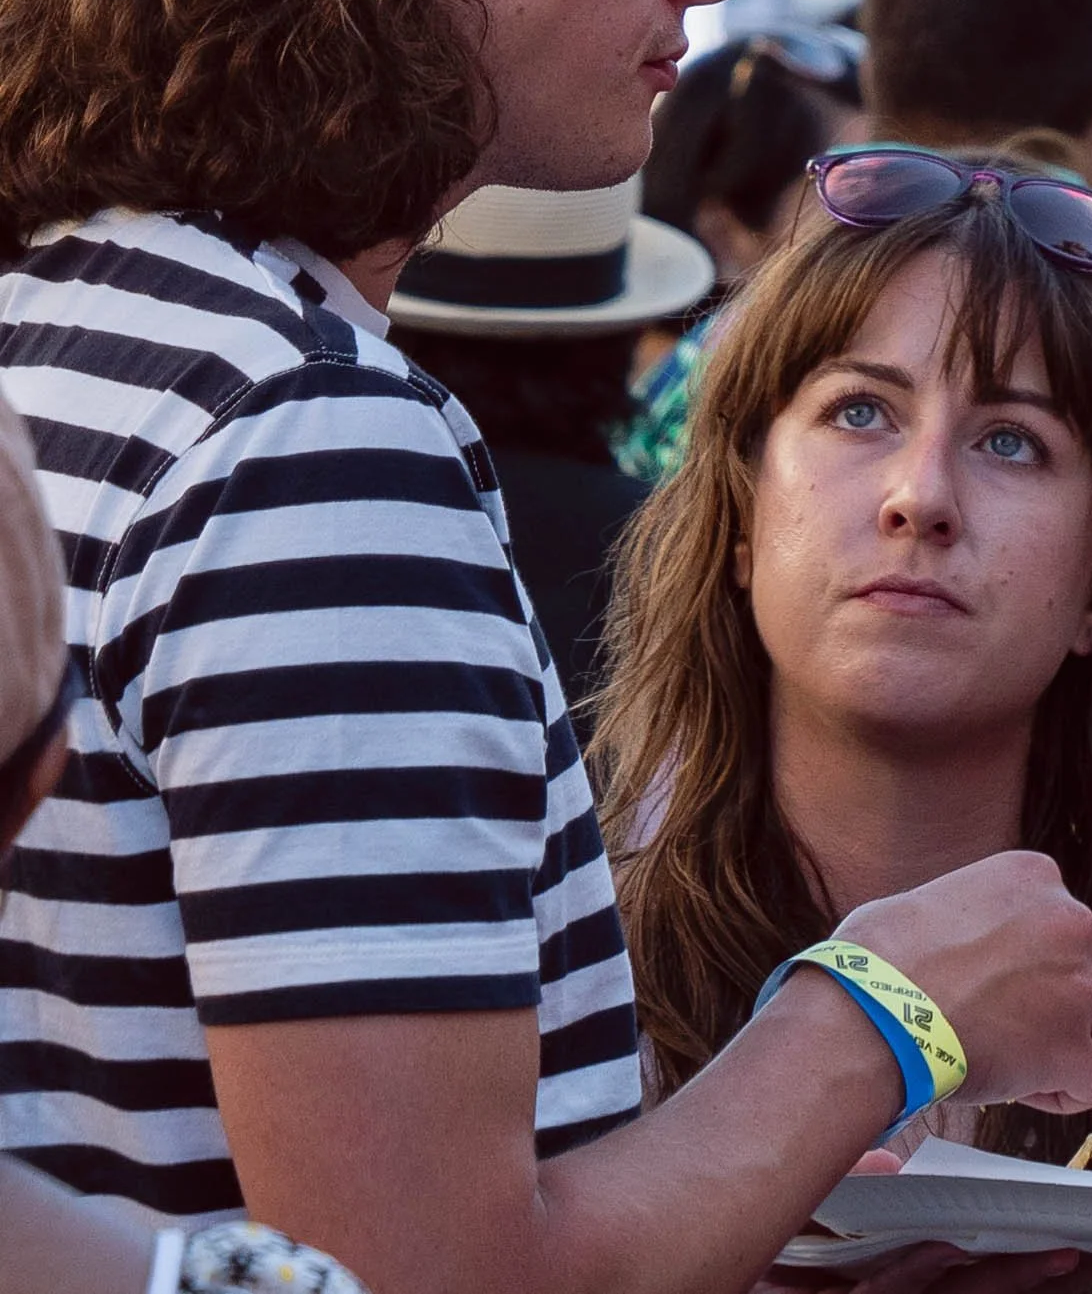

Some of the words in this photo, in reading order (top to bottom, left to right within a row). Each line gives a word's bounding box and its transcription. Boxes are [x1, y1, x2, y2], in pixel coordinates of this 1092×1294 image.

[836, 955, 869, 973] 21
[904, 1003, 933, 1033] 21
[936, 1047, 957, 1067] AGE
